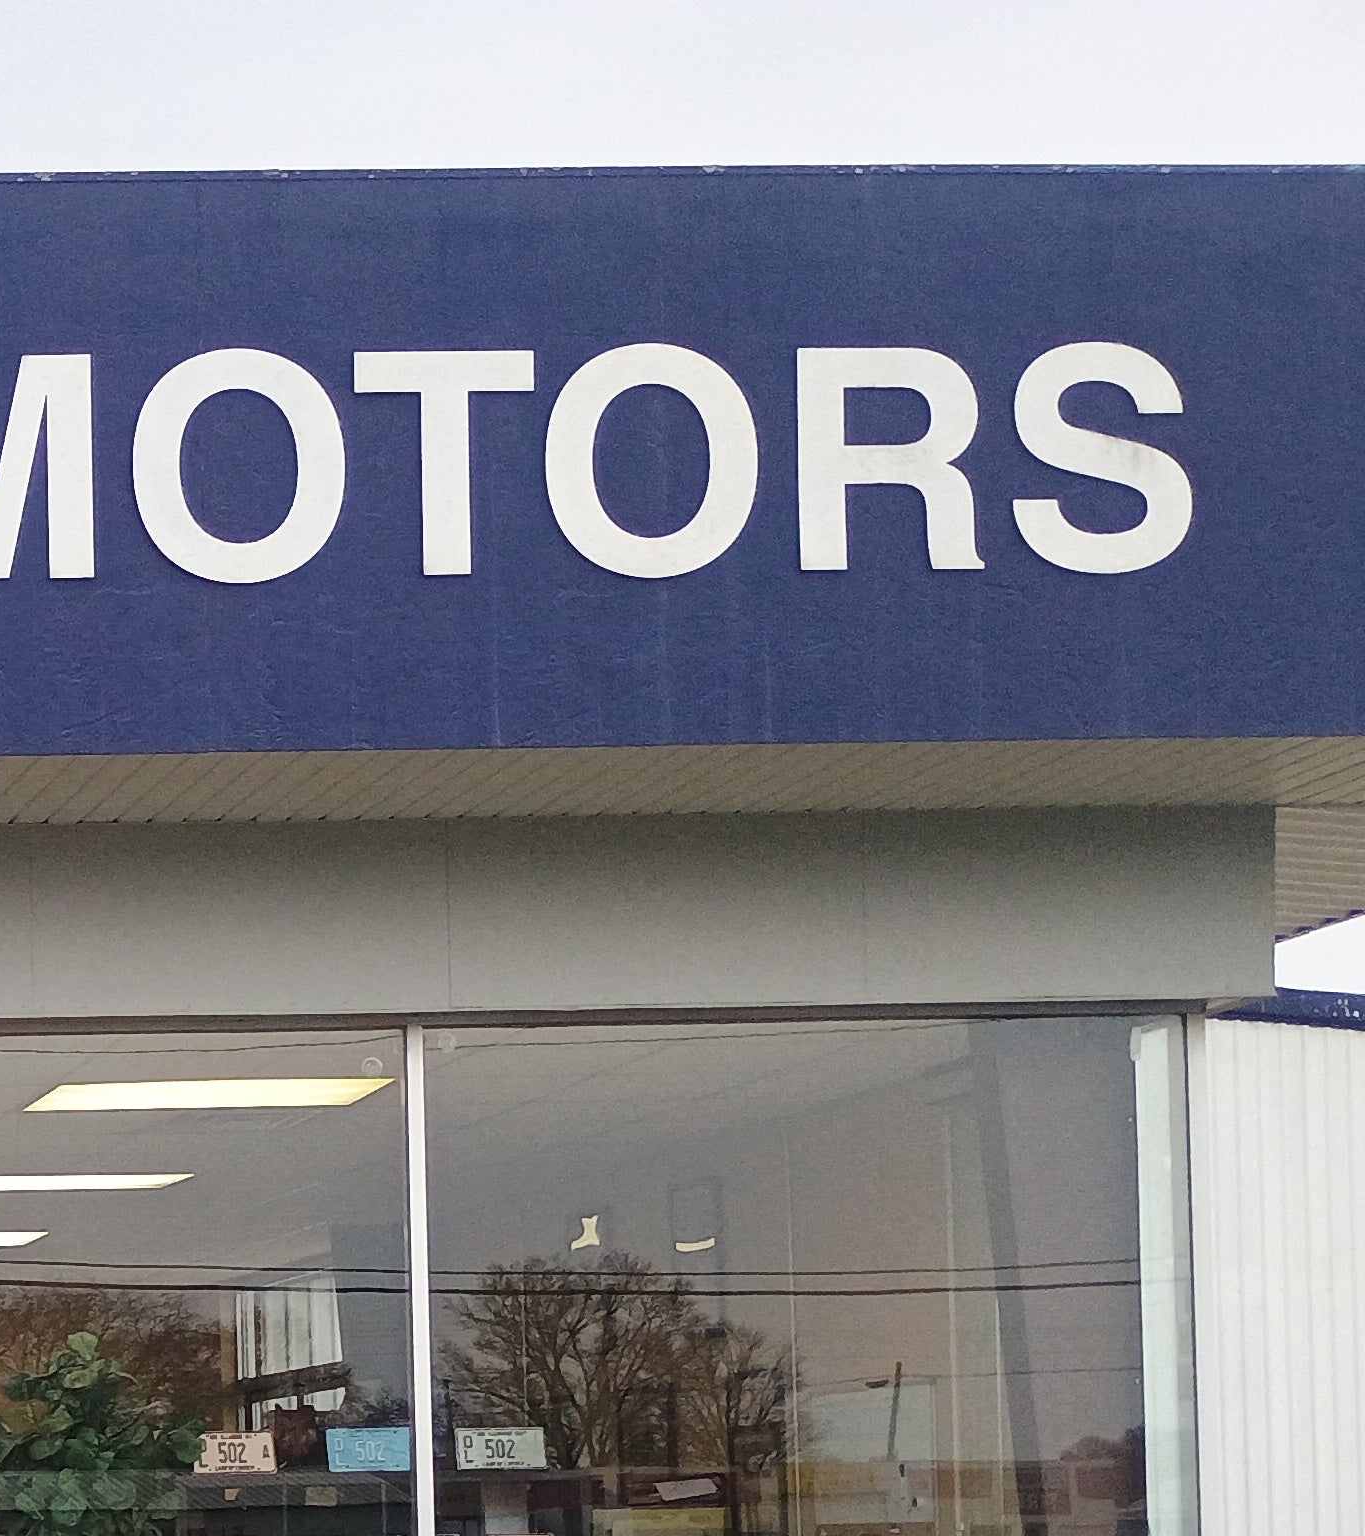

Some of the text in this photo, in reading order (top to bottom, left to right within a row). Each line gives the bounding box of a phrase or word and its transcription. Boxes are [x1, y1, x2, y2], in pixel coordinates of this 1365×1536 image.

[218, 1442, 247, 1463] 502
[355, 1440, 387, 1462] 502
[485, 1438, 516, 1459] 502
